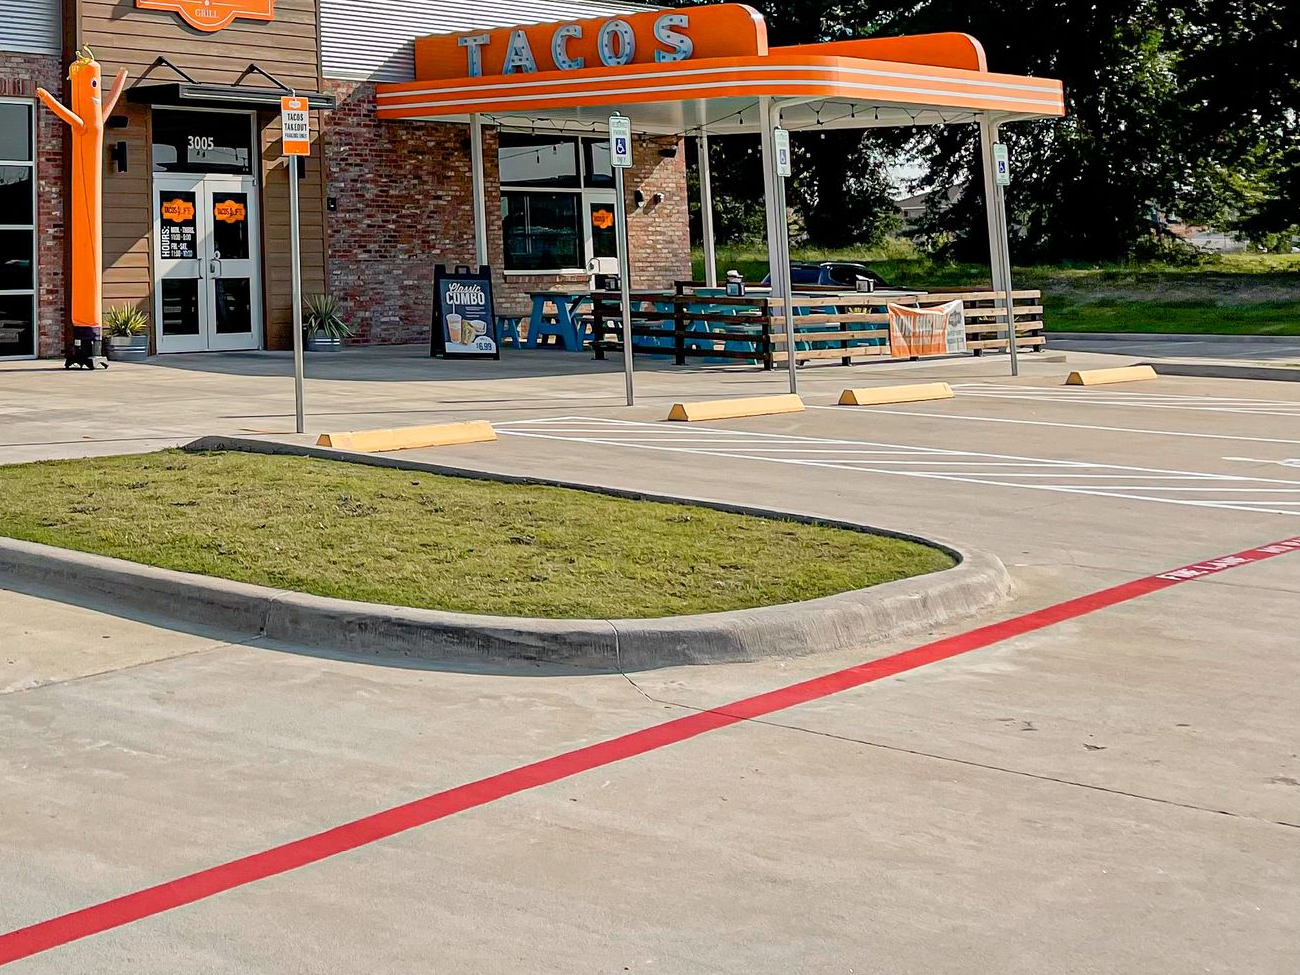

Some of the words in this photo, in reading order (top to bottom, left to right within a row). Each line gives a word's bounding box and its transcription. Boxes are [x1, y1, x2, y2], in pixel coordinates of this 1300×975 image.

[194, 8, 219, 19] GRILL
[457, 14, 693, 78] TACOS
[287, 113, 303, 121] TACOS
[284, 123, 307, 131] TAKEOUT
[187, 135, 214, 150] 3005
[162, 226, 170, 257] HOURS:
[448, 282, 481, 293] Classic
[446, 292, 485, 305] COMBO
[476, 342, 492, 351] $6.99
